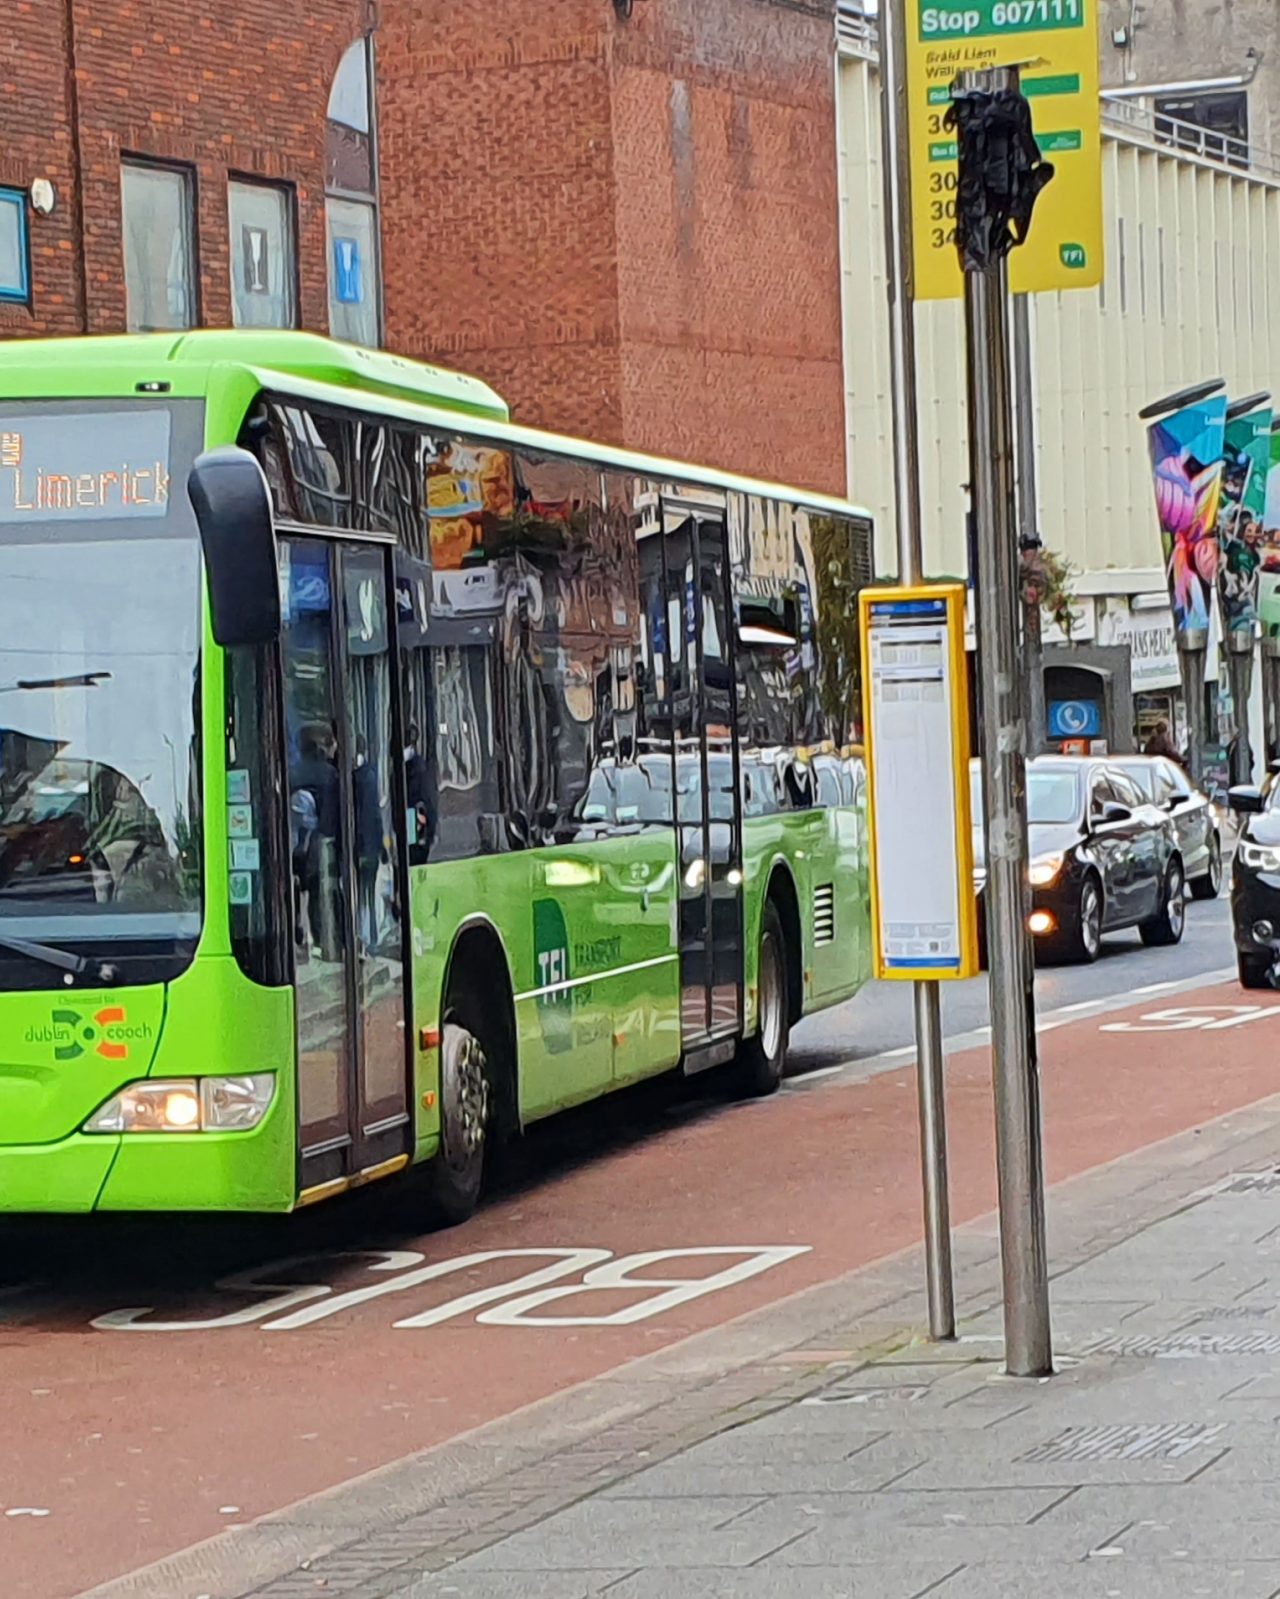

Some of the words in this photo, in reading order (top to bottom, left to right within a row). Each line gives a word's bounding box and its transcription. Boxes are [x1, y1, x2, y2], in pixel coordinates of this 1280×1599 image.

[921, 9, 980, 34] Stop
[992, 0, 1078, 26] 607111
[1061, 249, 1083, 263] TFI
[14, 461, 170, 510] Limerick
[538, 946, 569, 1005] TFI
[25, 1024, 70, 1042] dublin
[106, 1021, 153, 1039] coach
[89, 1244, 814, 1331] BUS
